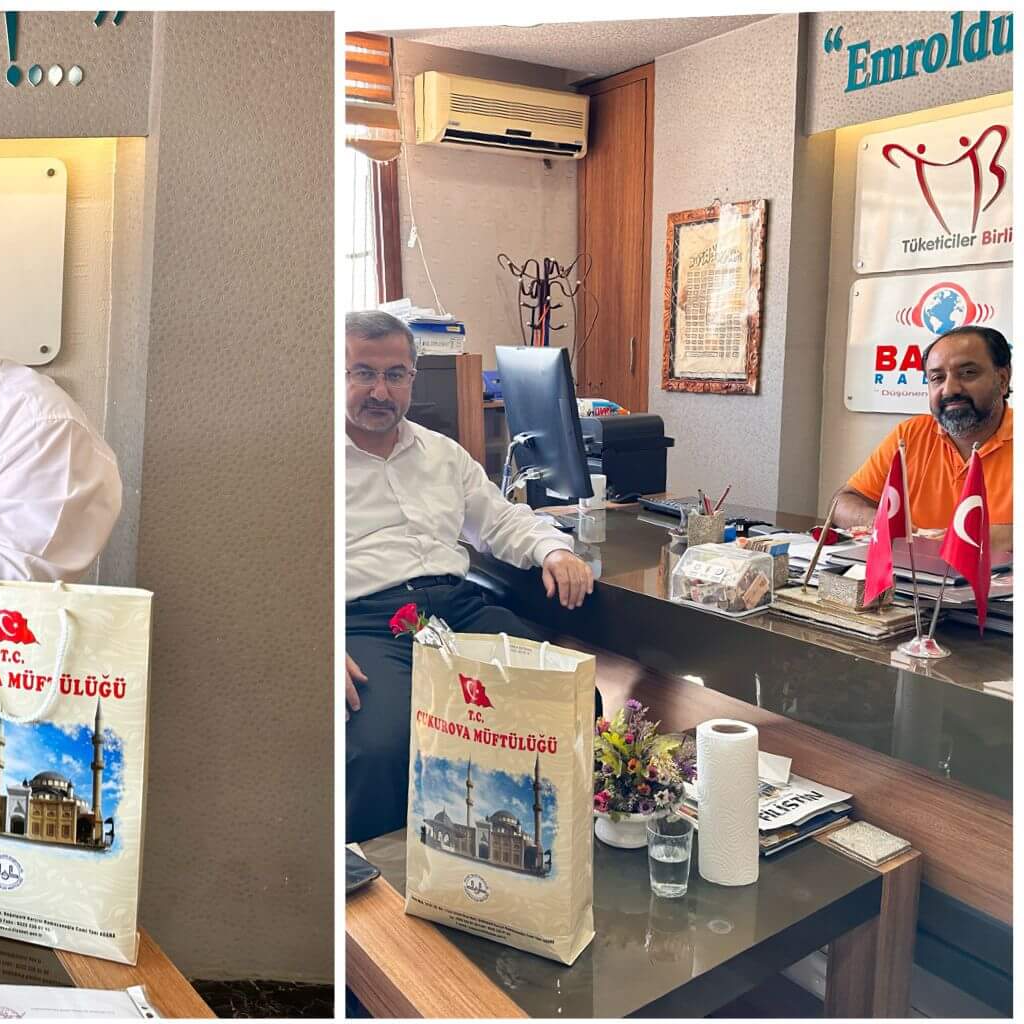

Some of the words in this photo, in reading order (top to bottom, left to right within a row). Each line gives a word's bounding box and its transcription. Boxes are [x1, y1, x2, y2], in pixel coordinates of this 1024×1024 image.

[902, 234, 977, 253] Tüketiciler
[0, 649, 25, 664] T.C.
[8, 670, 126, 699] MÜFÜLÜĞÜ
[468, 710, 485, 723] T.C.
[474, 728, 558, 754] MÜFTÜLÜĞÜ
